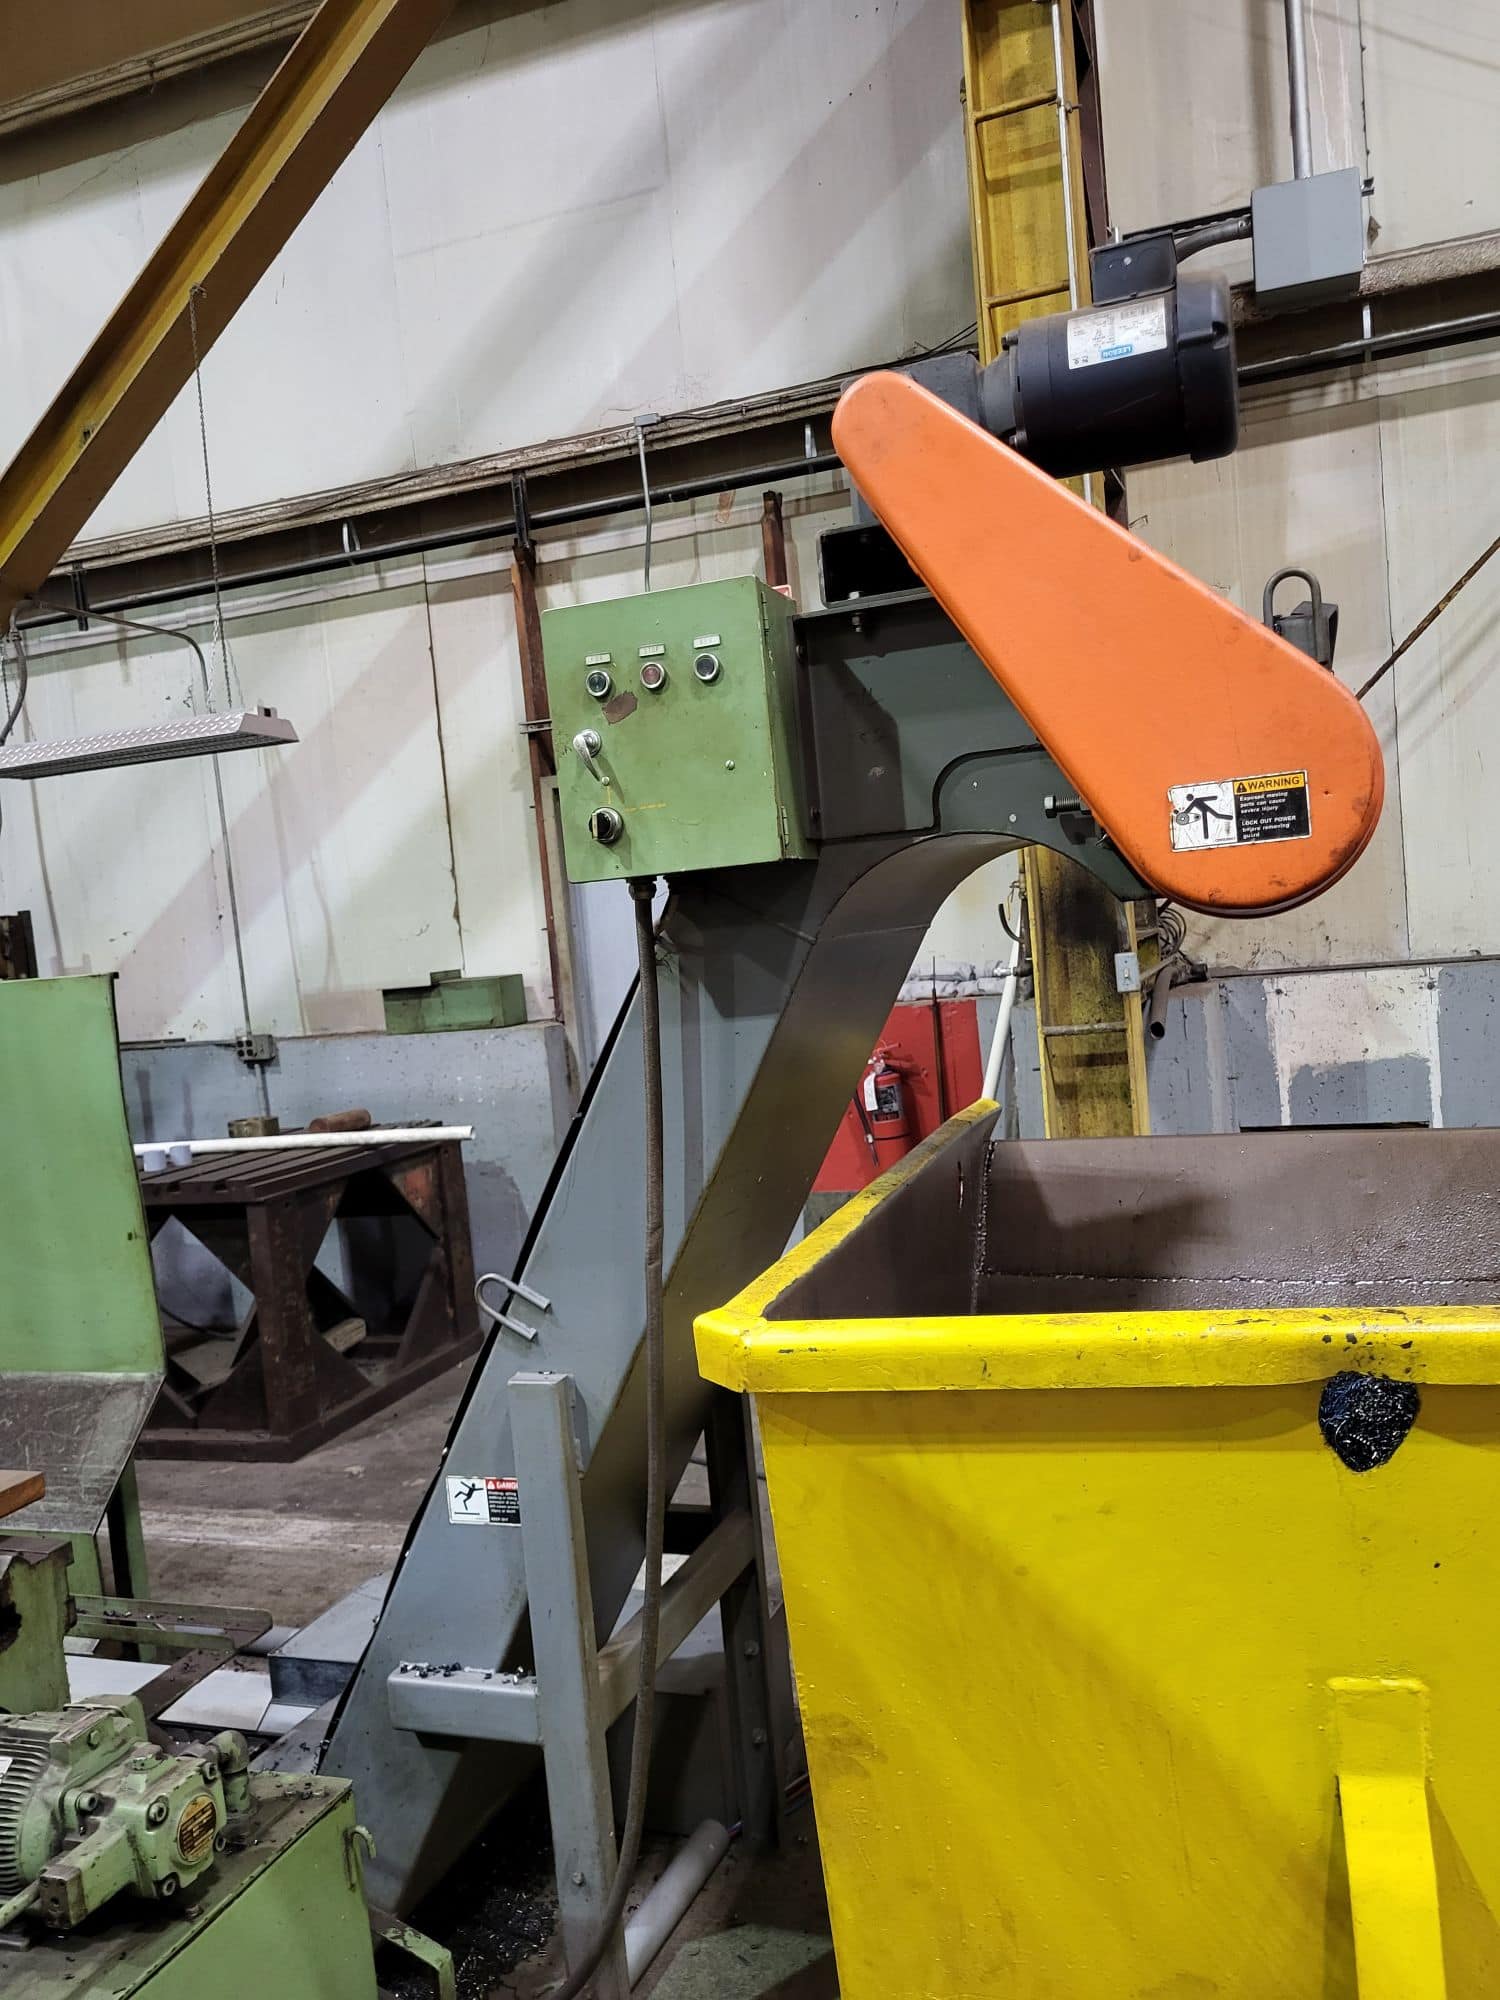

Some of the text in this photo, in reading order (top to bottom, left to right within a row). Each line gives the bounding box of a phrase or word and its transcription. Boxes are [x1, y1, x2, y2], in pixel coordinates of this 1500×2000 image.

[1248, 776, 1300, 790] WARNING
[1240, 794, 1264, 802] Exposed
[1259, 817, 1273, 825] OUT
